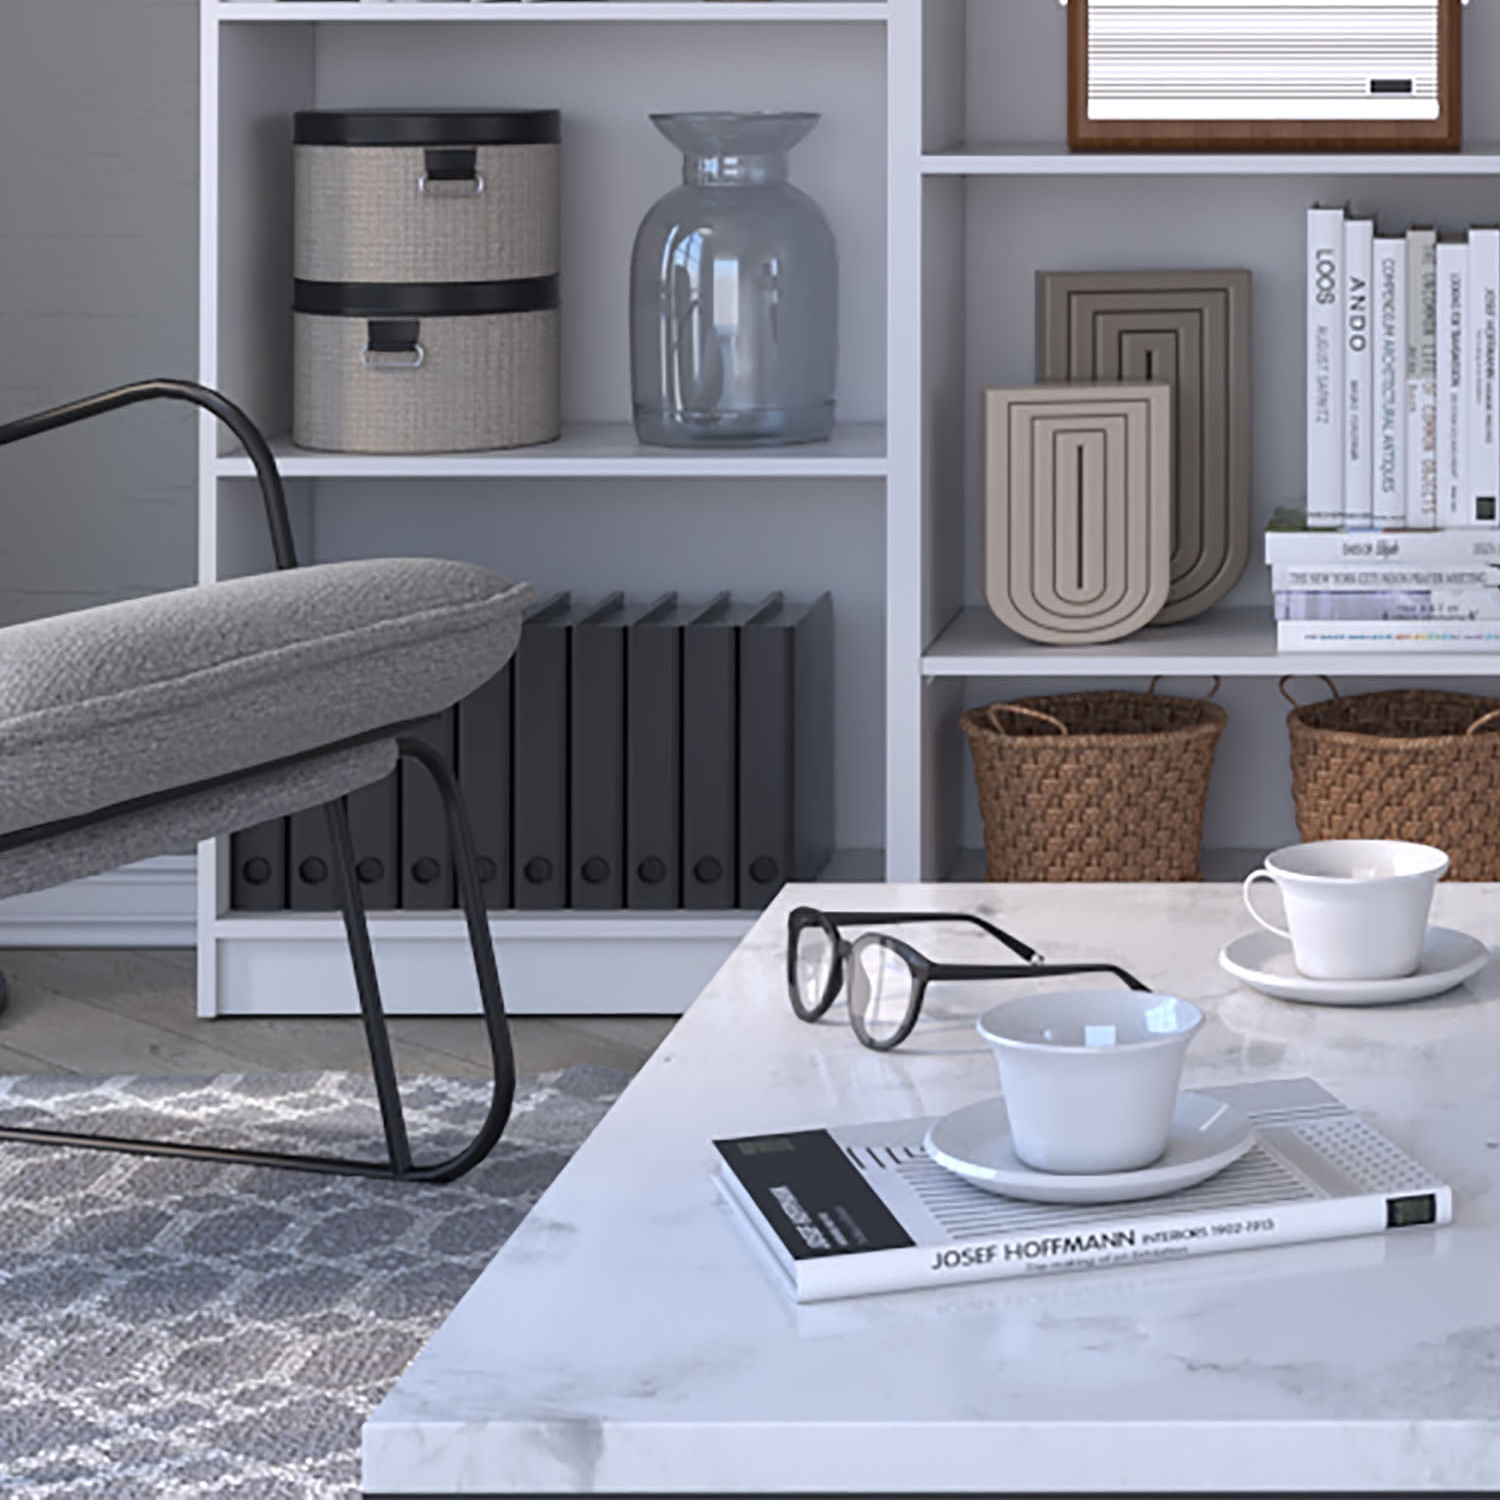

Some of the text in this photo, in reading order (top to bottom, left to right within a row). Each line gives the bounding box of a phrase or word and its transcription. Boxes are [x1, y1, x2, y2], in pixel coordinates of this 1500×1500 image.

[1316, 249, 1335, 305] LOOS
[1349, 277, 1366, 351] ANDO
[931, 1245, 996, 1270] JOSEF
[1004, 1229, 1136, 1262] HOFFMANN
[1141, 1226, 1209, 1245] INTERIORS
